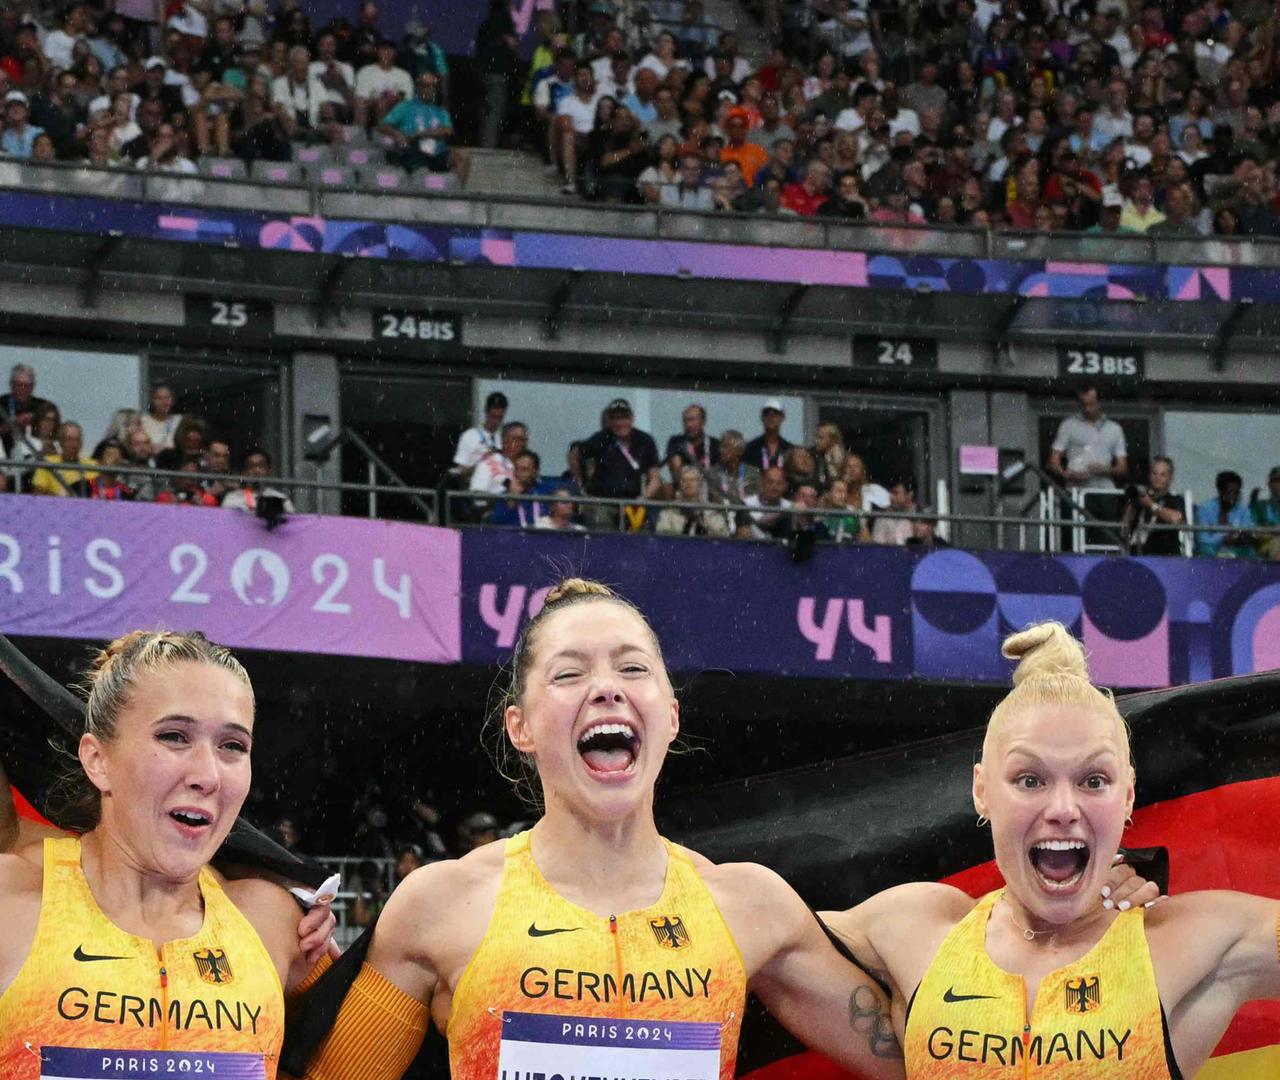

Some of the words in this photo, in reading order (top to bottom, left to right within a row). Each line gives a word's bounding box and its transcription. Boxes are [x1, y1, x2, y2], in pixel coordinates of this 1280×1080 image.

[211, 301, 248, 327] 25
[878, 341, 913, 365] 24
[169, 542, 412, 620] 2024
[519, 966, 713, 1003] GERMANY
[57, 986, 262, 1035] GERMANY
[562, 1022, 618, 1040] PARiS
[625, 1026, 673, 1041] 2024
[927, 1026, 1132, 1067] GERMANY
[102, 1056, 158, 1073] PARiS
[166, 1058, 216, 1074] 2024
